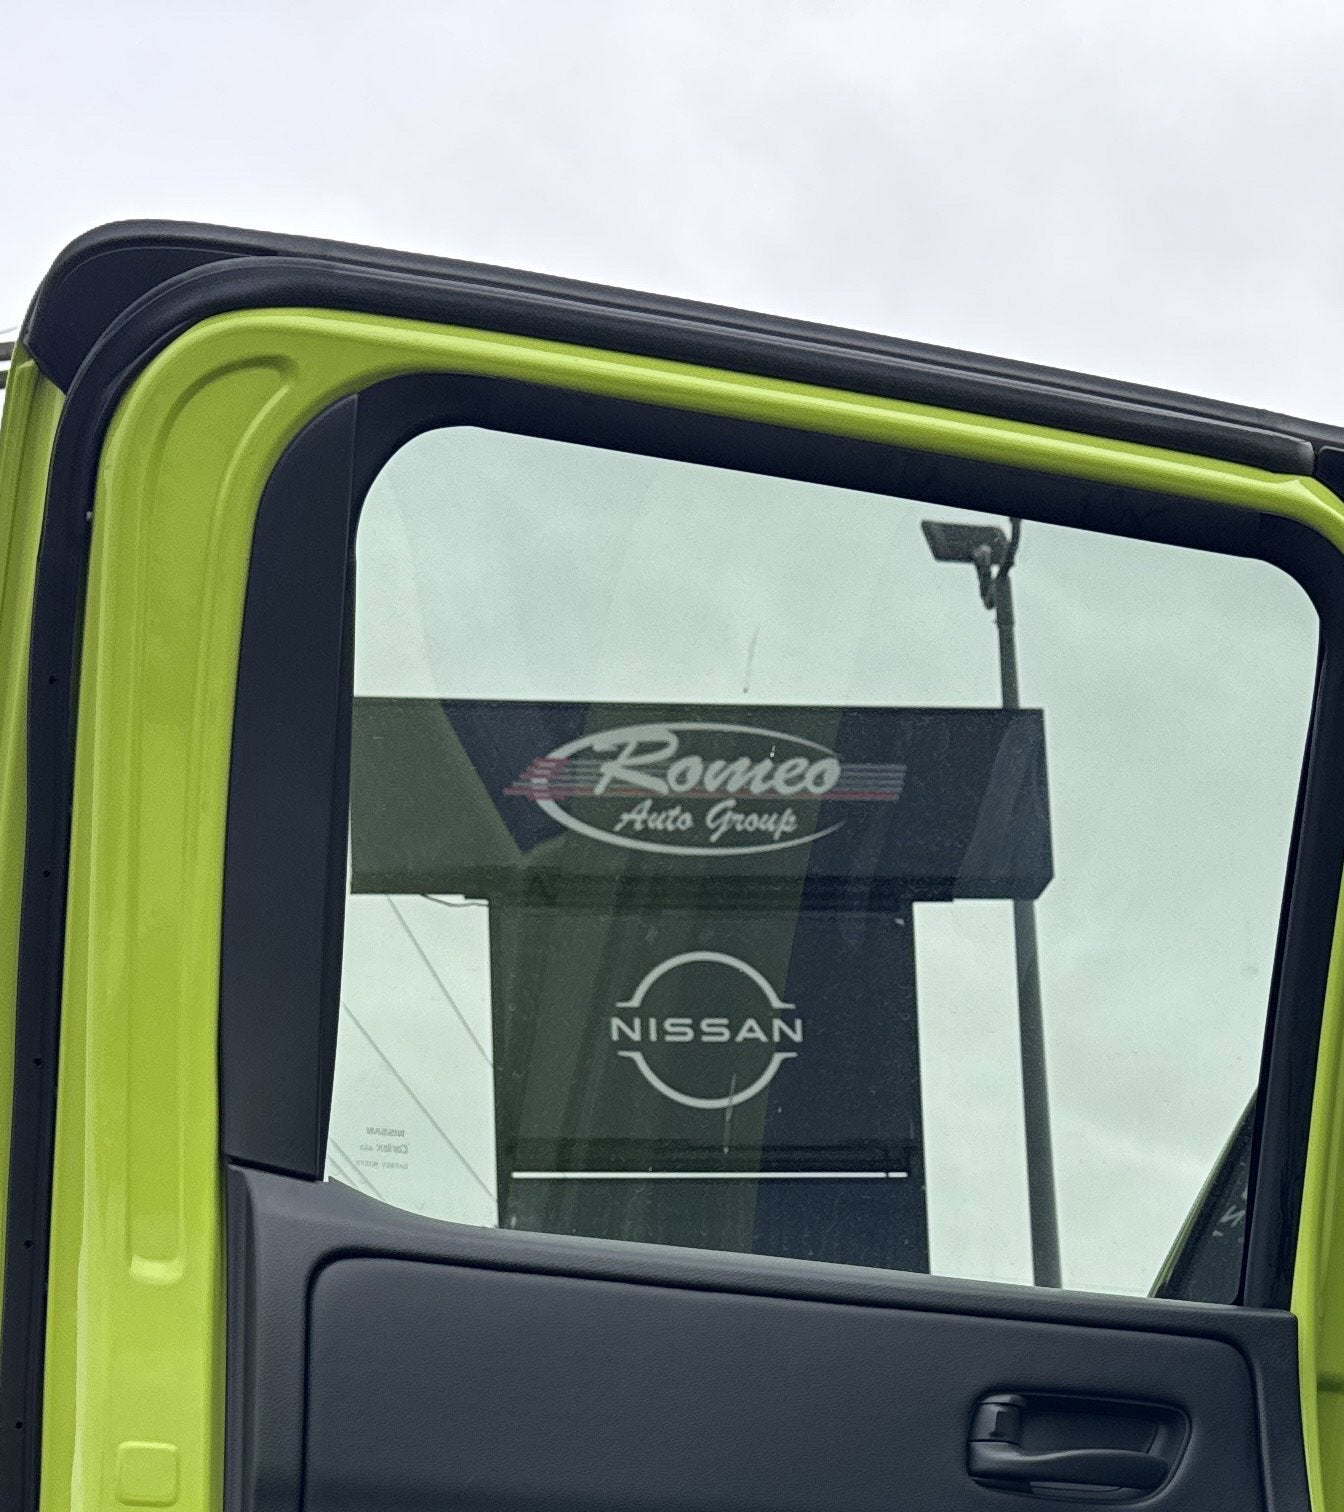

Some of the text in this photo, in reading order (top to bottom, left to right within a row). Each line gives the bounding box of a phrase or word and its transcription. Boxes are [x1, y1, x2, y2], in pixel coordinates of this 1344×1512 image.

[594, 726, 842, 796] Romeo
[613, 799, 798, 842] Auto Group
[610, 1017, 803, 1043] NISSAN
